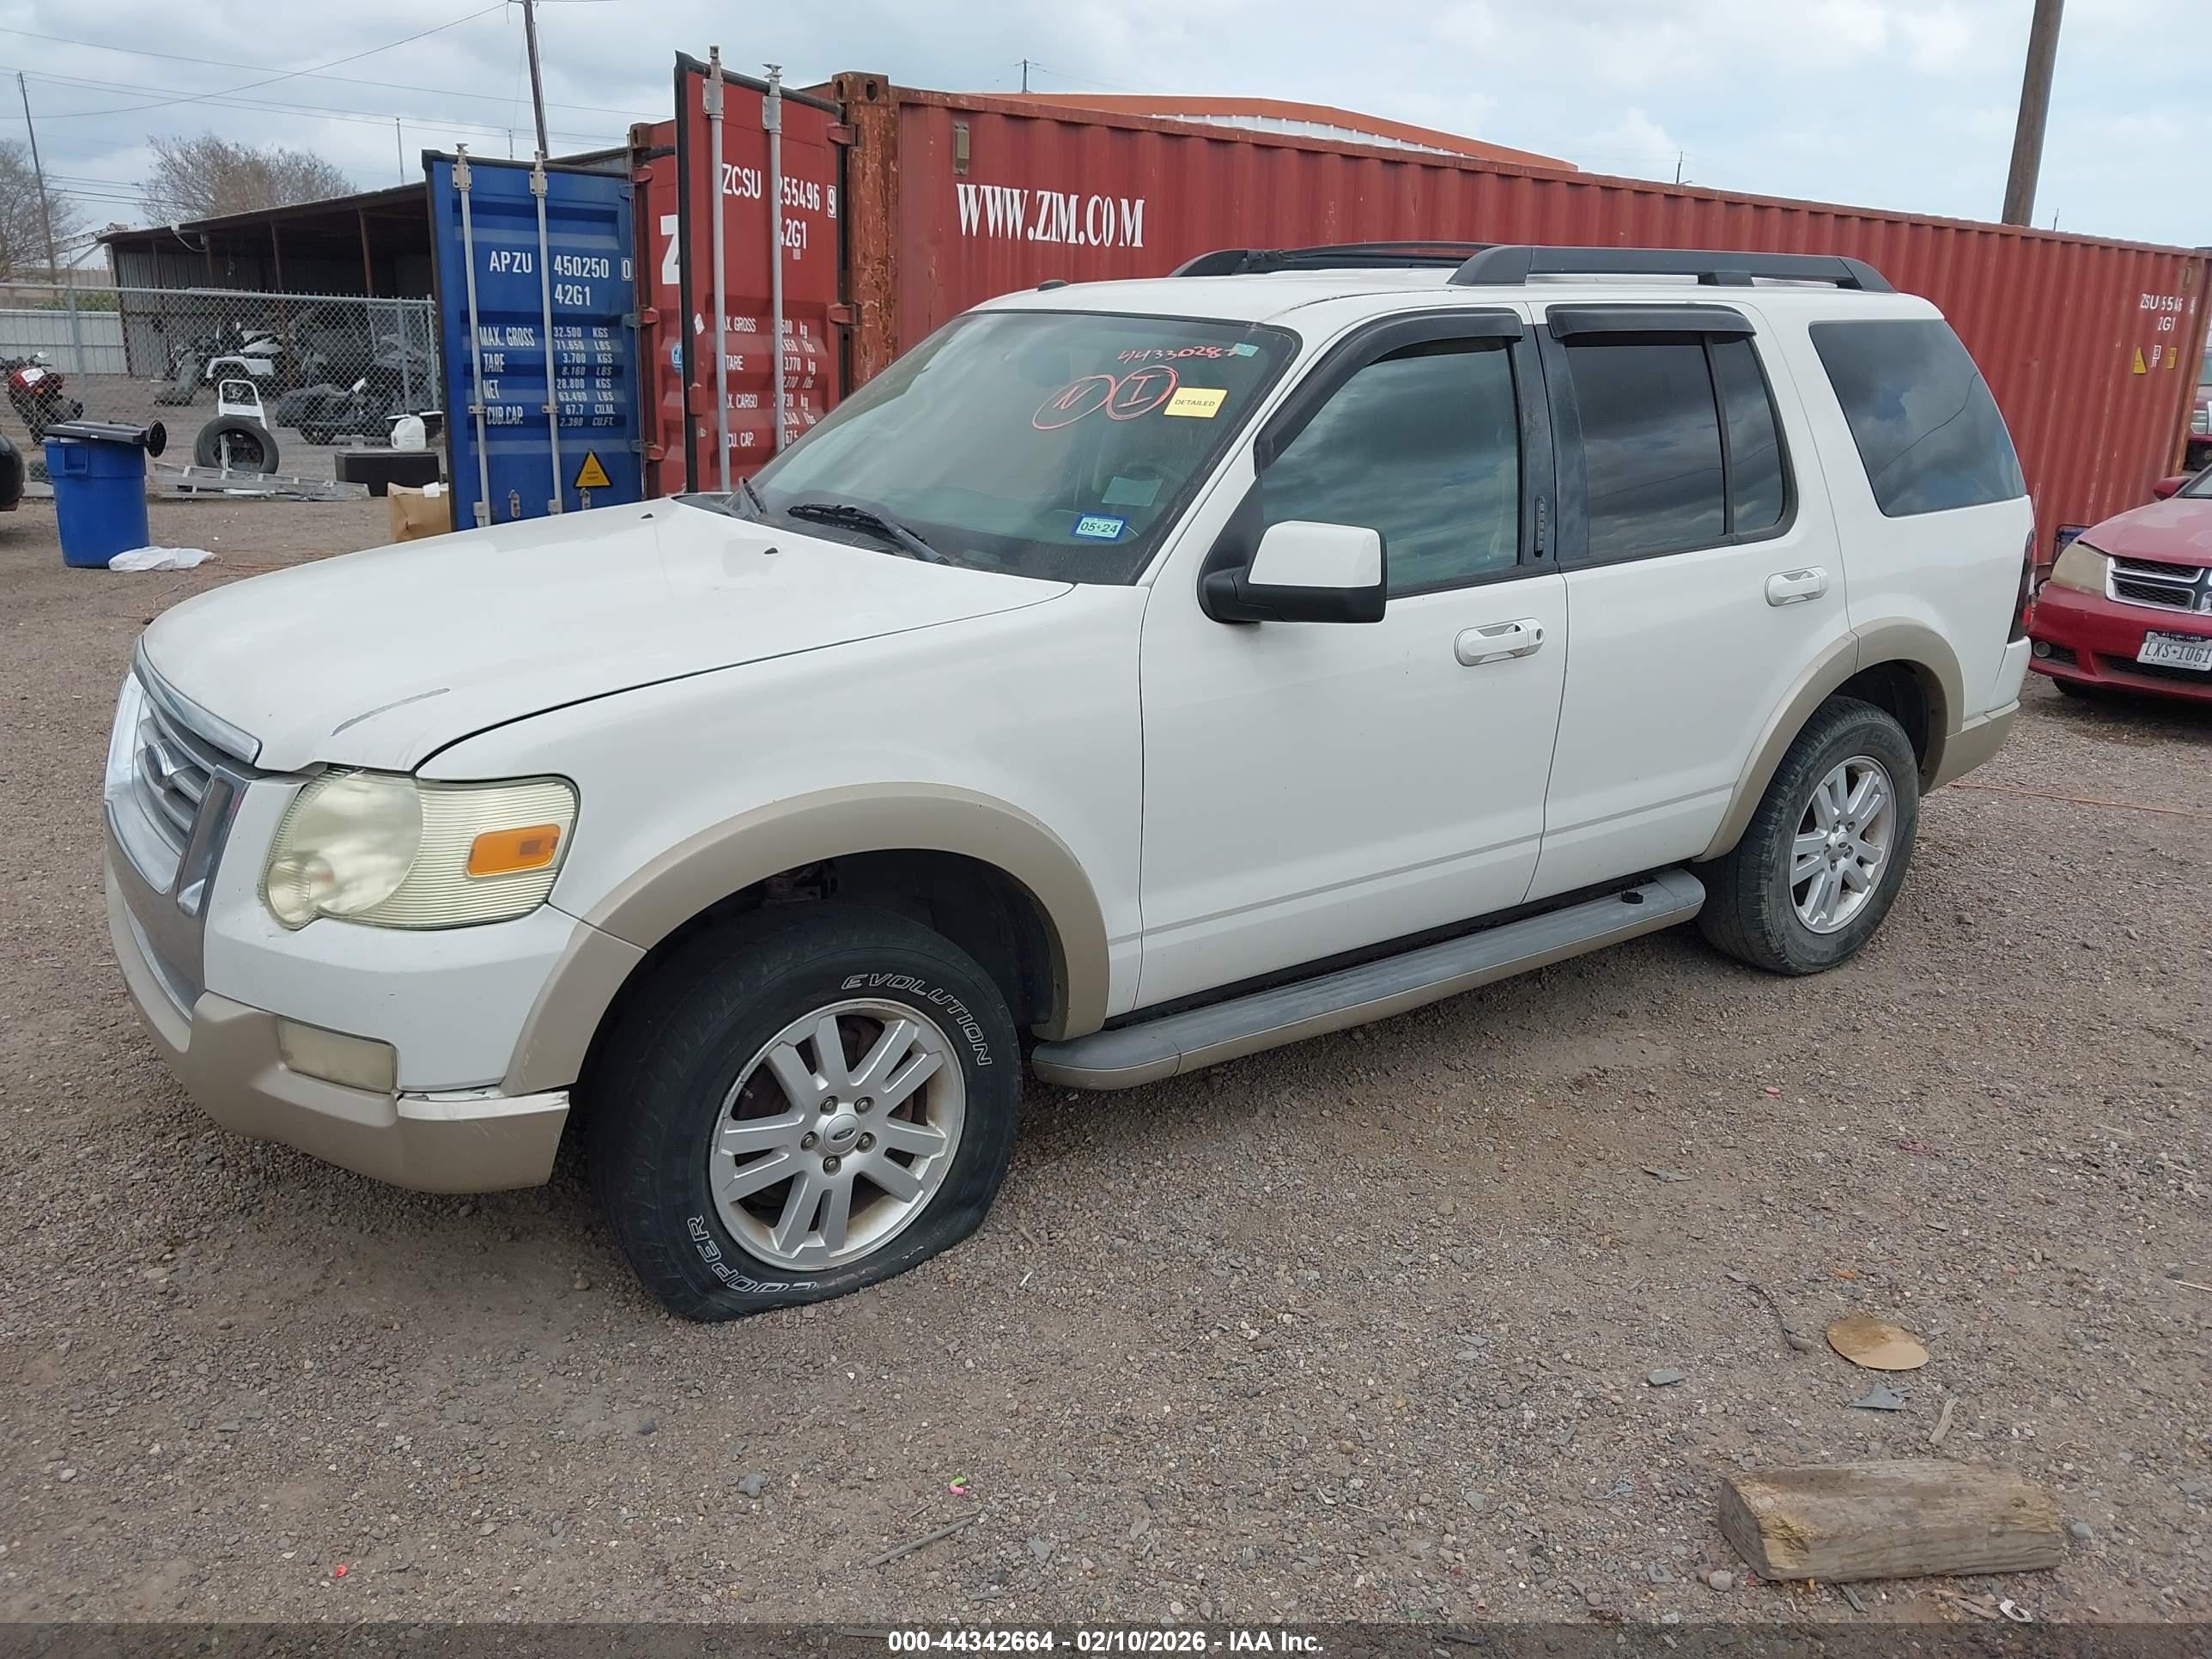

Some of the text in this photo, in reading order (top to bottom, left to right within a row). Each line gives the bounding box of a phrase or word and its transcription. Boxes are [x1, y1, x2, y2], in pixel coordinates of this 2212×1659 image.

[722, 163, 762, 199] ZCSU
[828, 187, 836, 216] 9
[956, 183, 1145, 247] WWW.ZIM.COM
[489, 251, 631, 280] APZU 450250 0
[555, 284, 591, 306] 42G1
[734, 317, 757, 333] GROSS
[479, 326, 609, 347] MAX. GROSS 32.500 KGS
[594, 341, 611, 350] LBS
[483, 353, 613, 373] TARE 3.700 KGS
[725, 355, 744, 371] TARE
[596, 367, 612, 376] LBS
[556, 379, 586, 389] 28.800
[595, 379, 612, 389] KGS
[597, 392, 615, 401] LBS
[736, 394, 758, 409] CARGO
[566, 404, 584, 415] 67.7
[842, 974, 993, 1066] EVOLUTION
